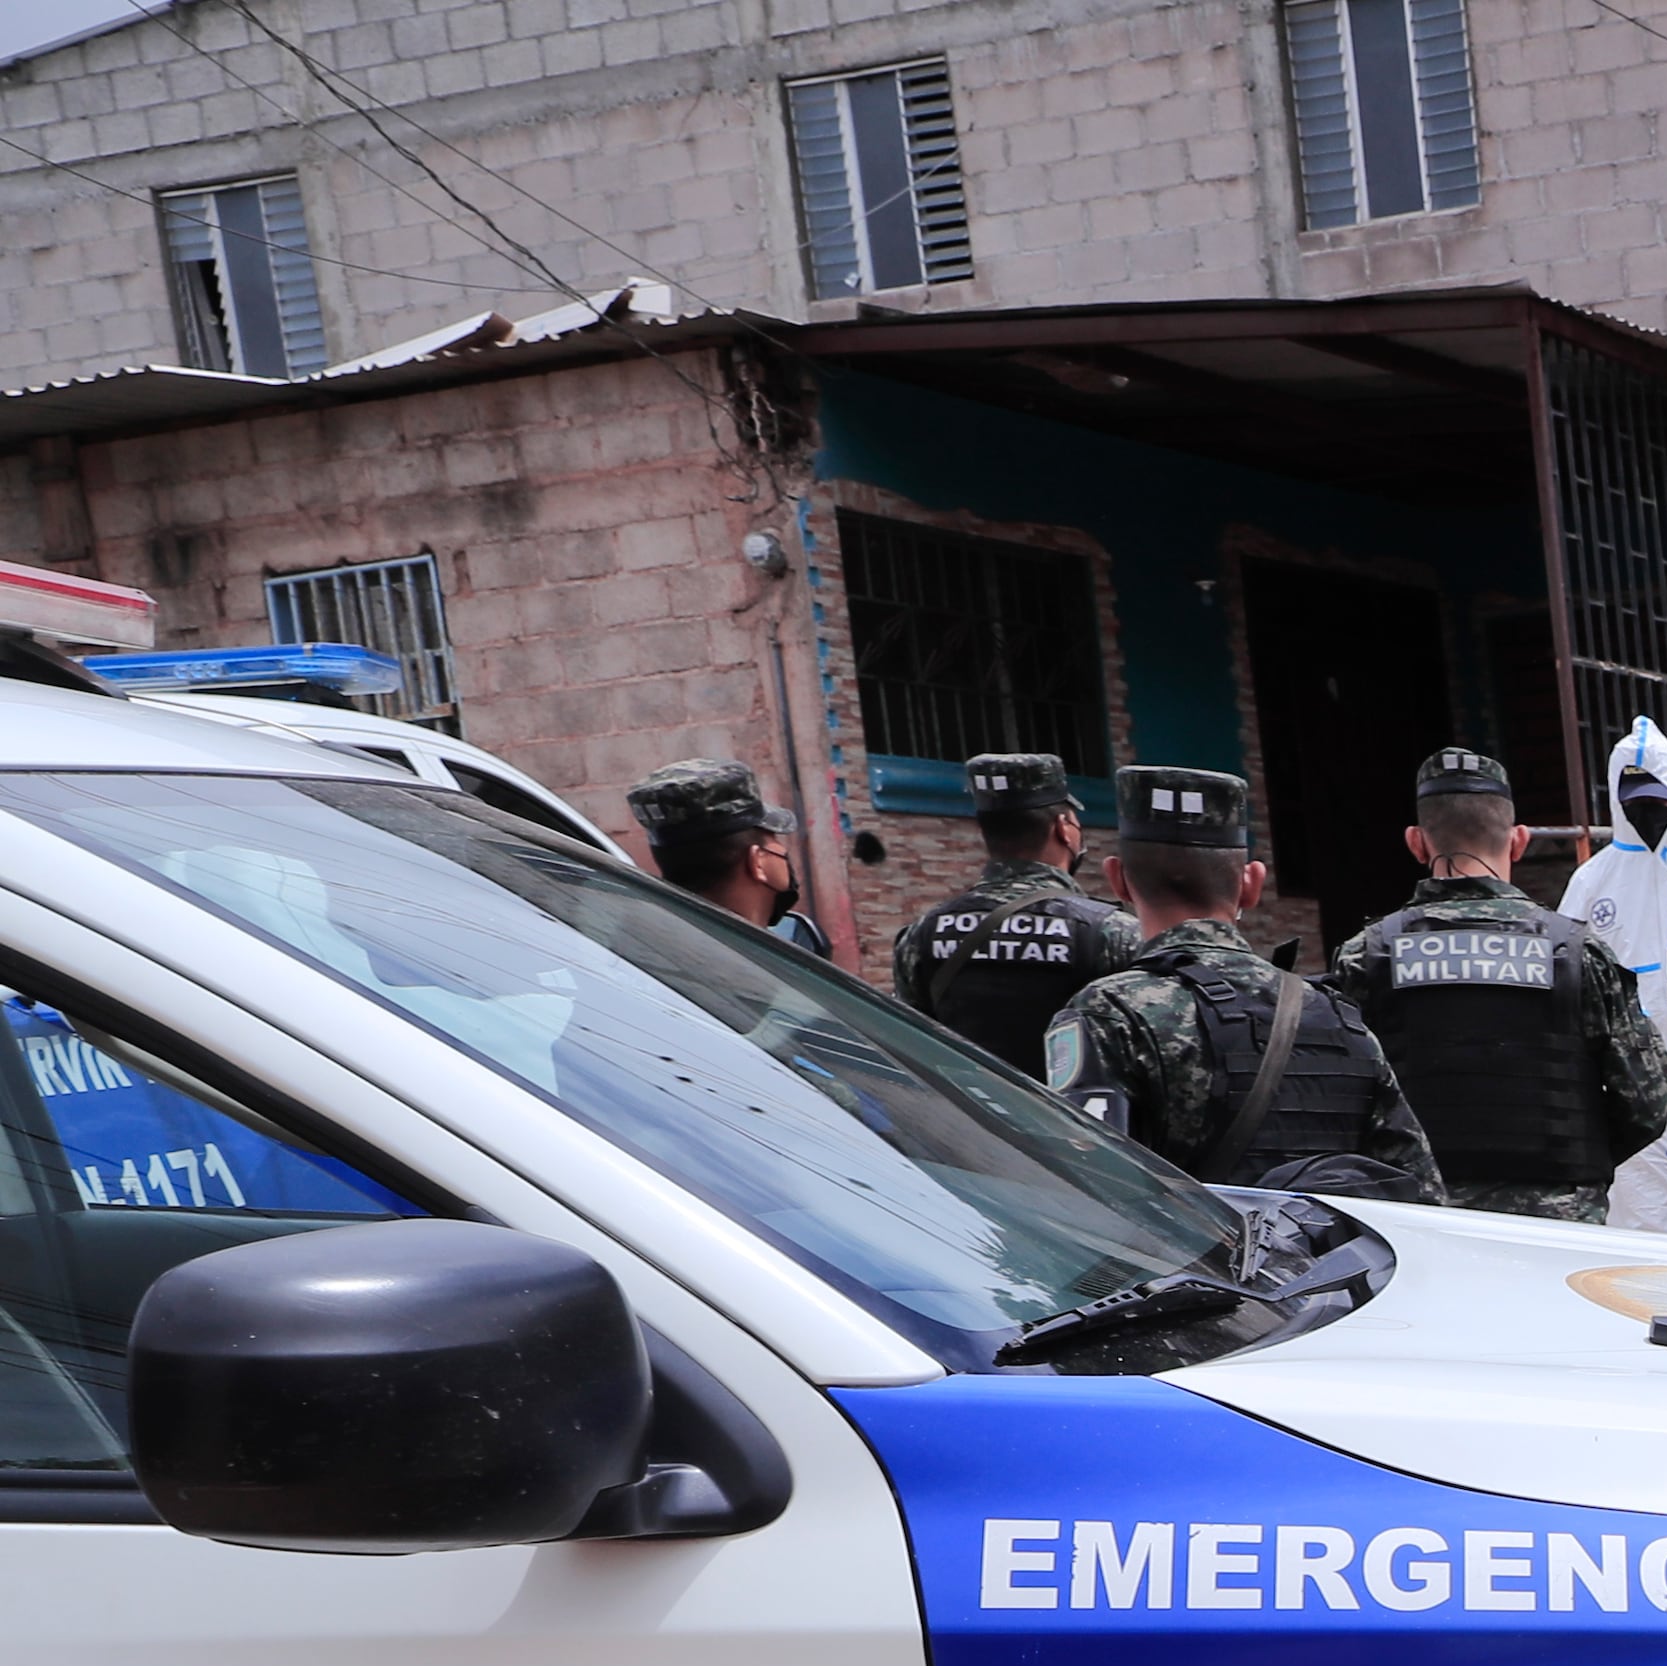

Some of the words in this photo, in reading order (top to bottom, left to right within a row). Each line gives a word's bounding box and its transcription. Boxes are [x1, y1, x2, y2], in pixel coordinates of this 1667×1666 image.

[936, 913, 1071, 938] POICIA
[932, 939, 1070, 963] MITAR
[1395, 934, 1546, 959] POLICIA
[1396, 959, 1549, 985] MILITAR
[16, 1034, 133, 1097] RVIR
